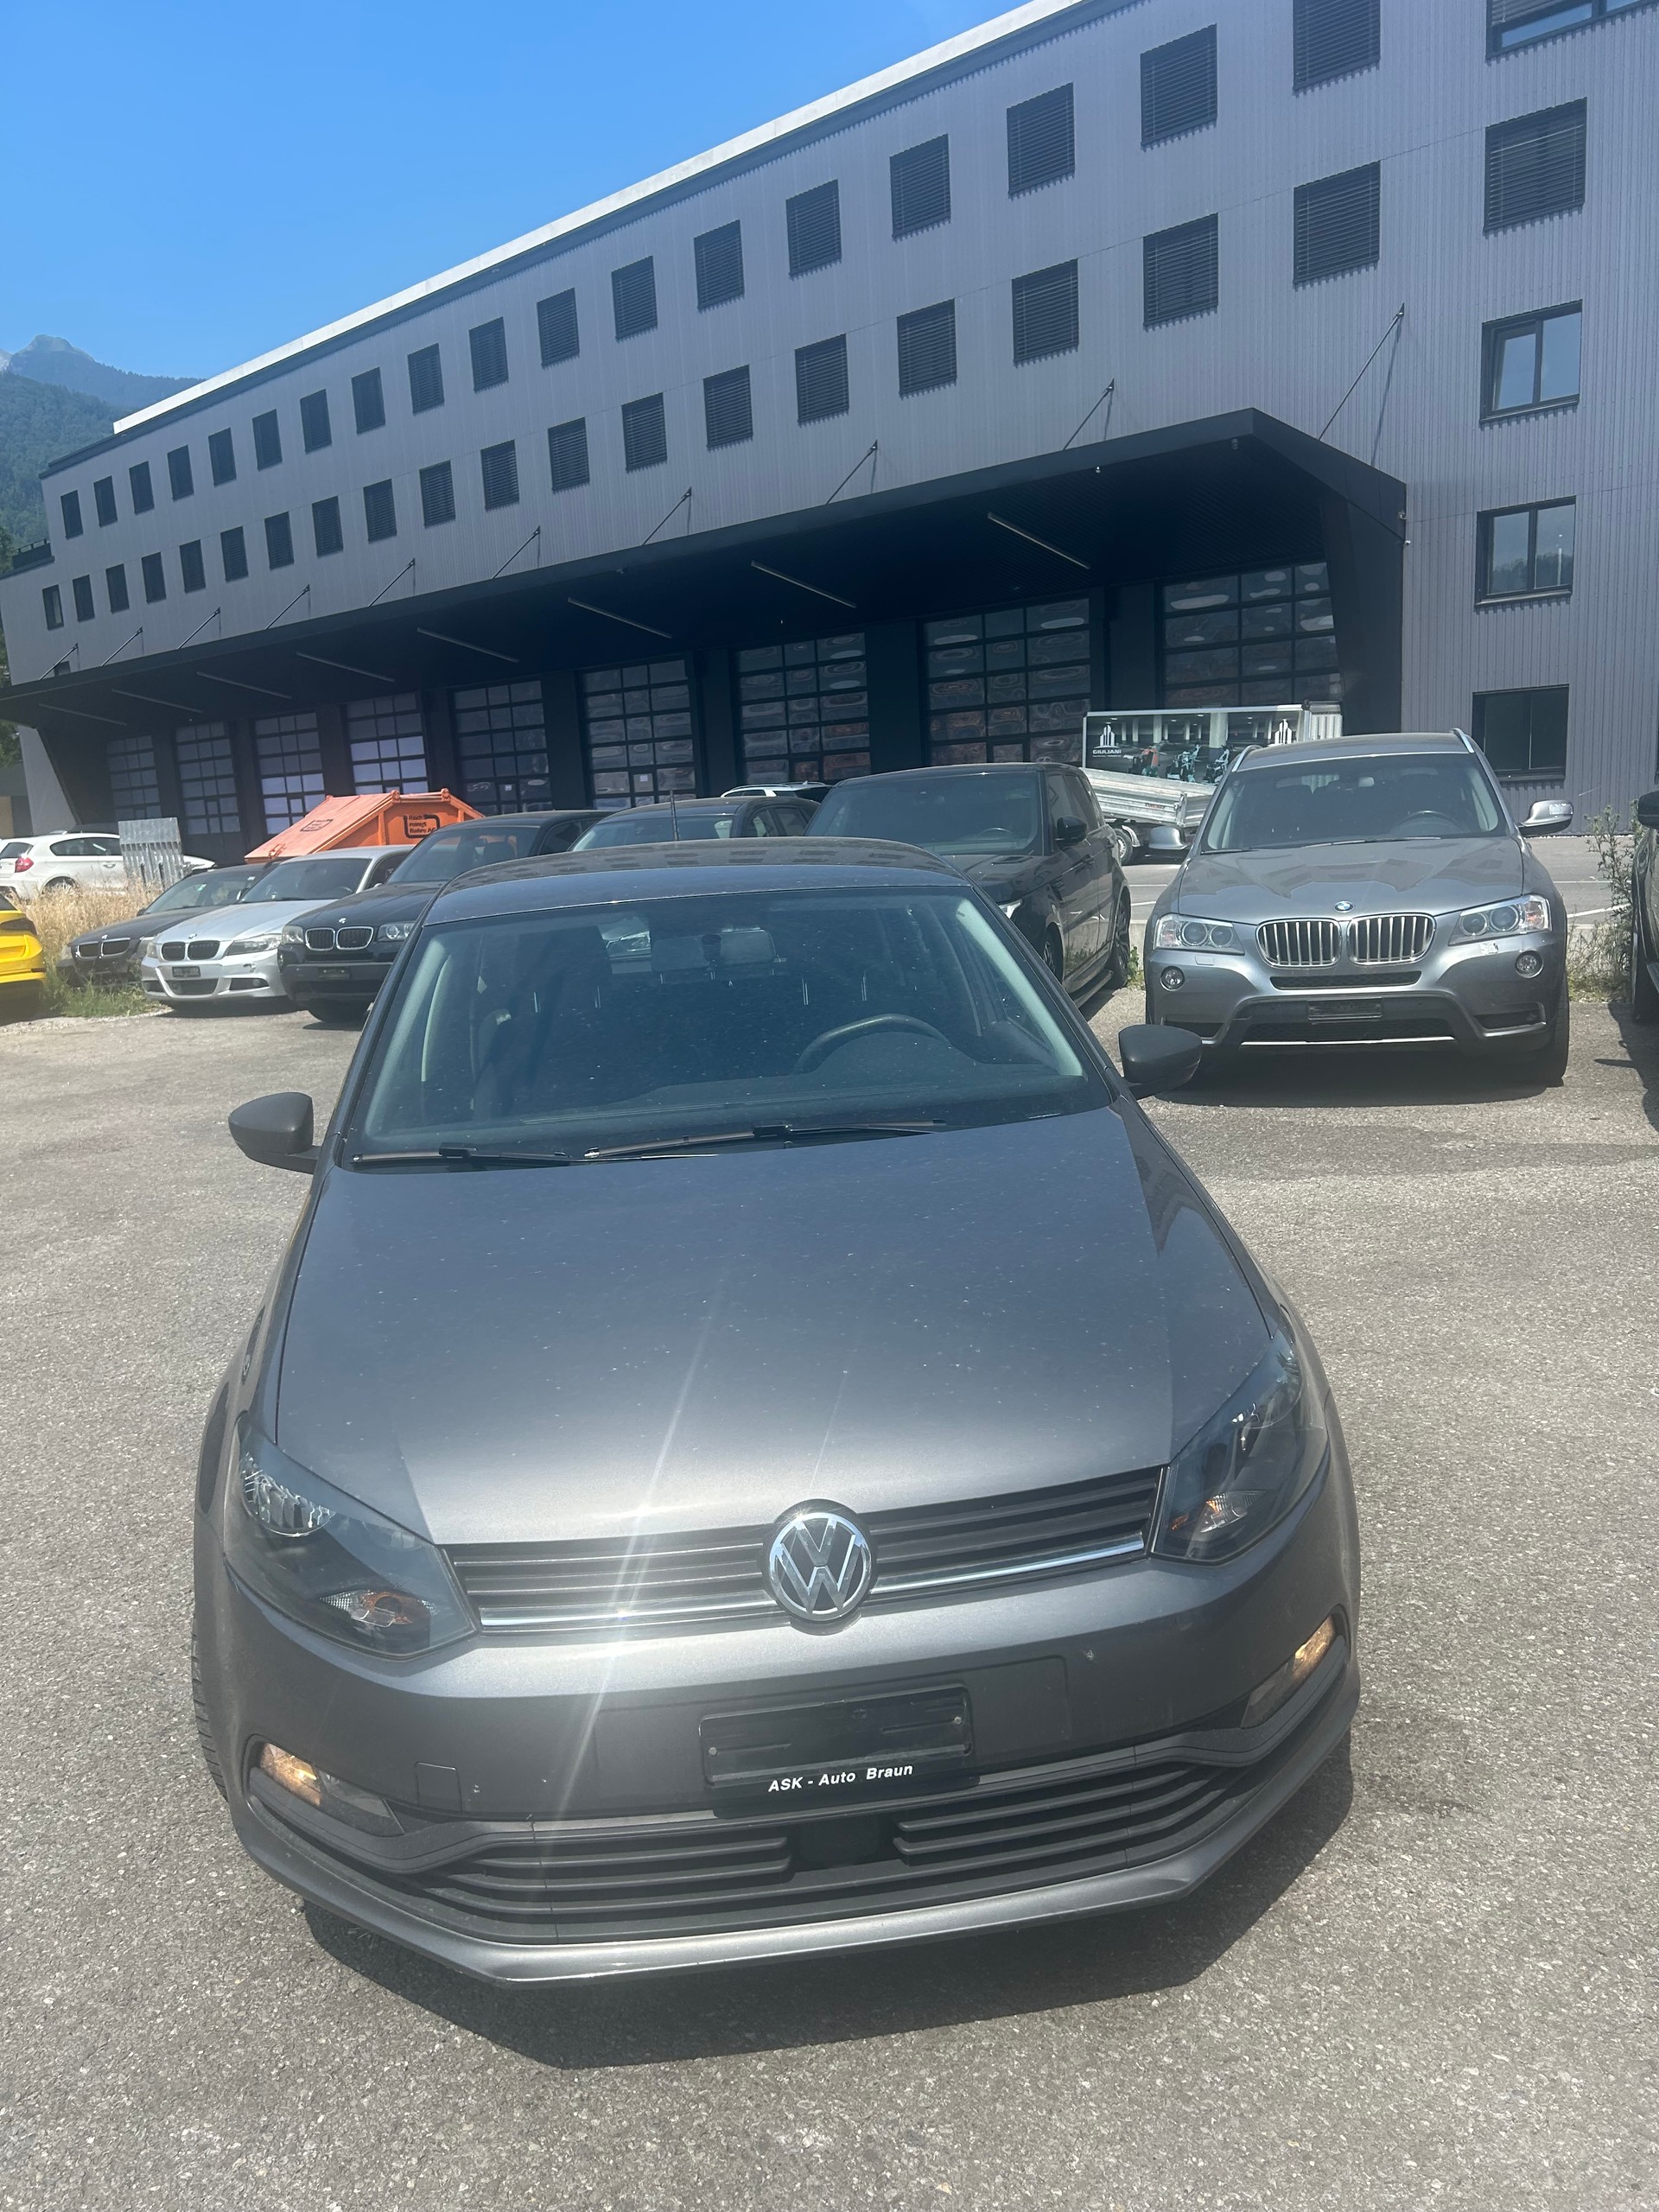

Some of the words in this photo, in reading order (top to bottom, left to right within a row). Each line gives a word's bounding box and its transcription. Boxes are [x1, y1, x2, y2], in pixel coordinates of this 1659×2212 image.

[768, 1777, 804, 1792] ASK
[818, 1771, 856, 1786] Auto
[866, 1764, 913, 1780] Braun
